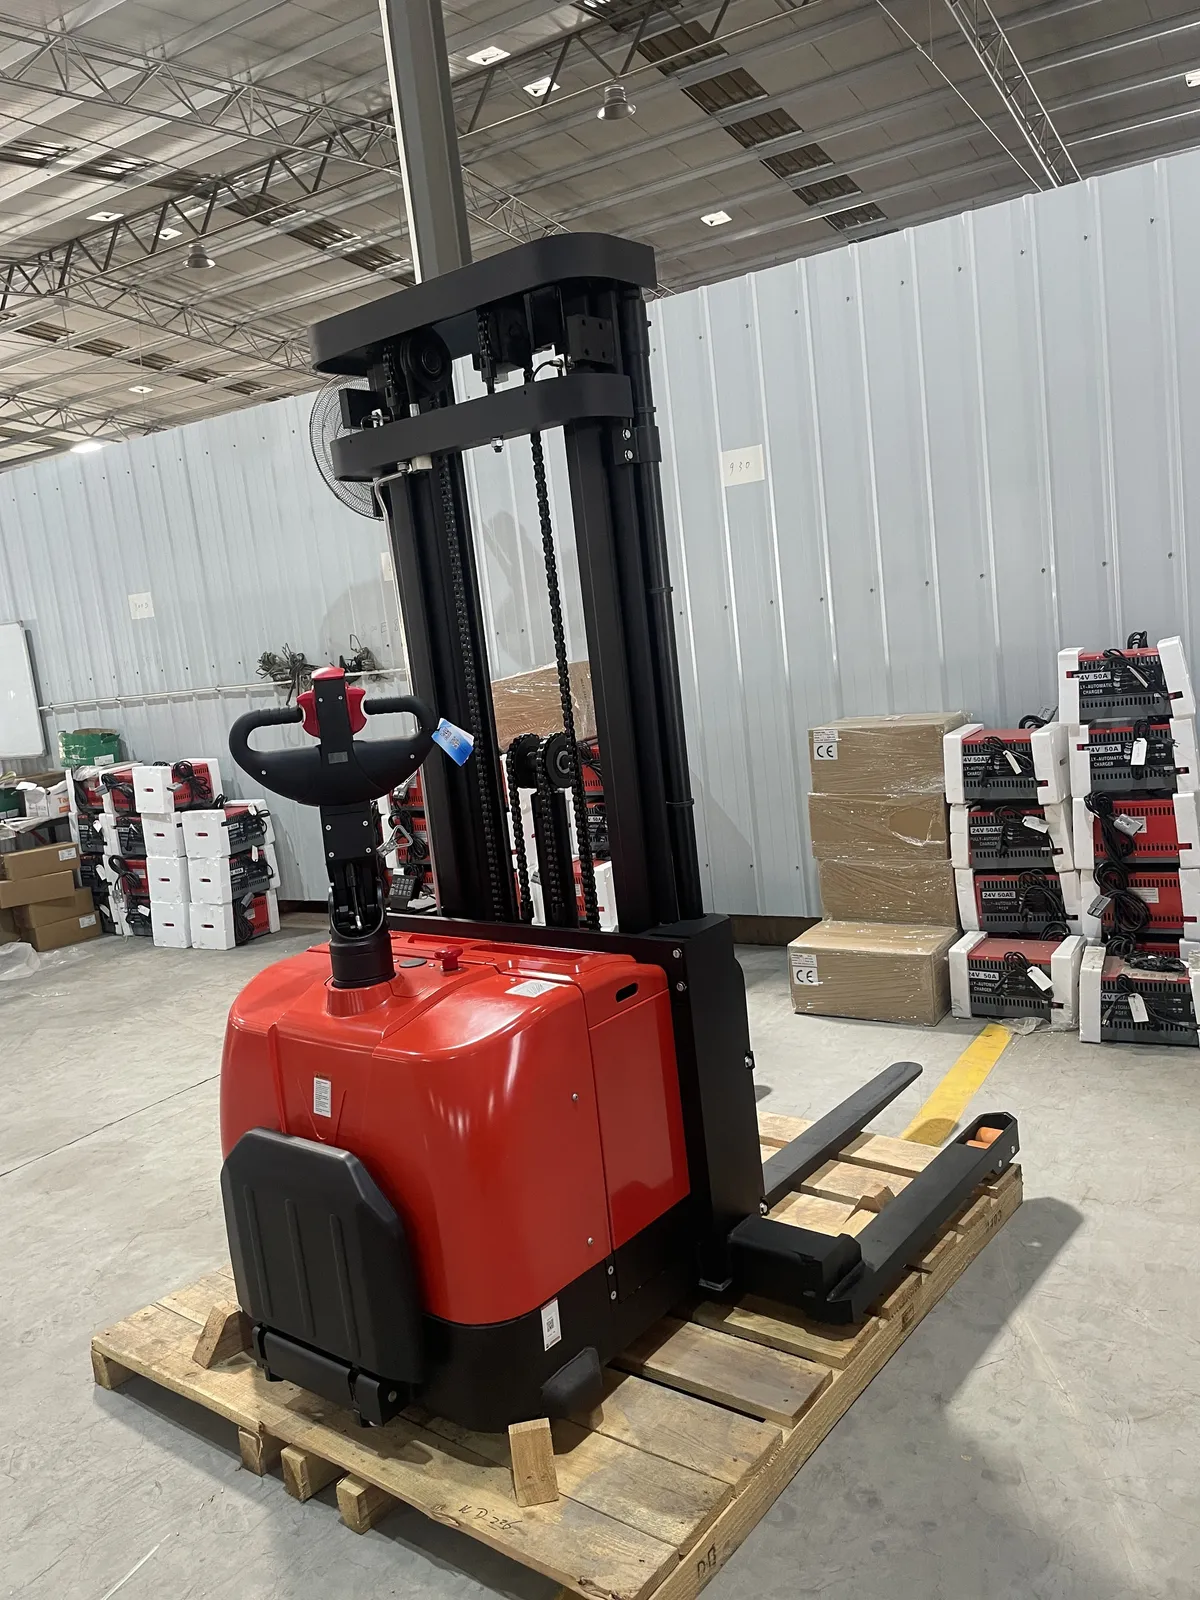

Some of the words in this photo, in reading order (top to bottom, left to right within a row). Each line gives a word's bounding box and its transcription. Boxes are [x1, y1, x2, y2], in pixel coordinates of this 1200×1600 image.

[1093, 672, 1108, 680] 50A
[816, 745, 834, 758] CE
[1104, 745, 1119, 753] 50A
[796, 969, 814, 983] CE
